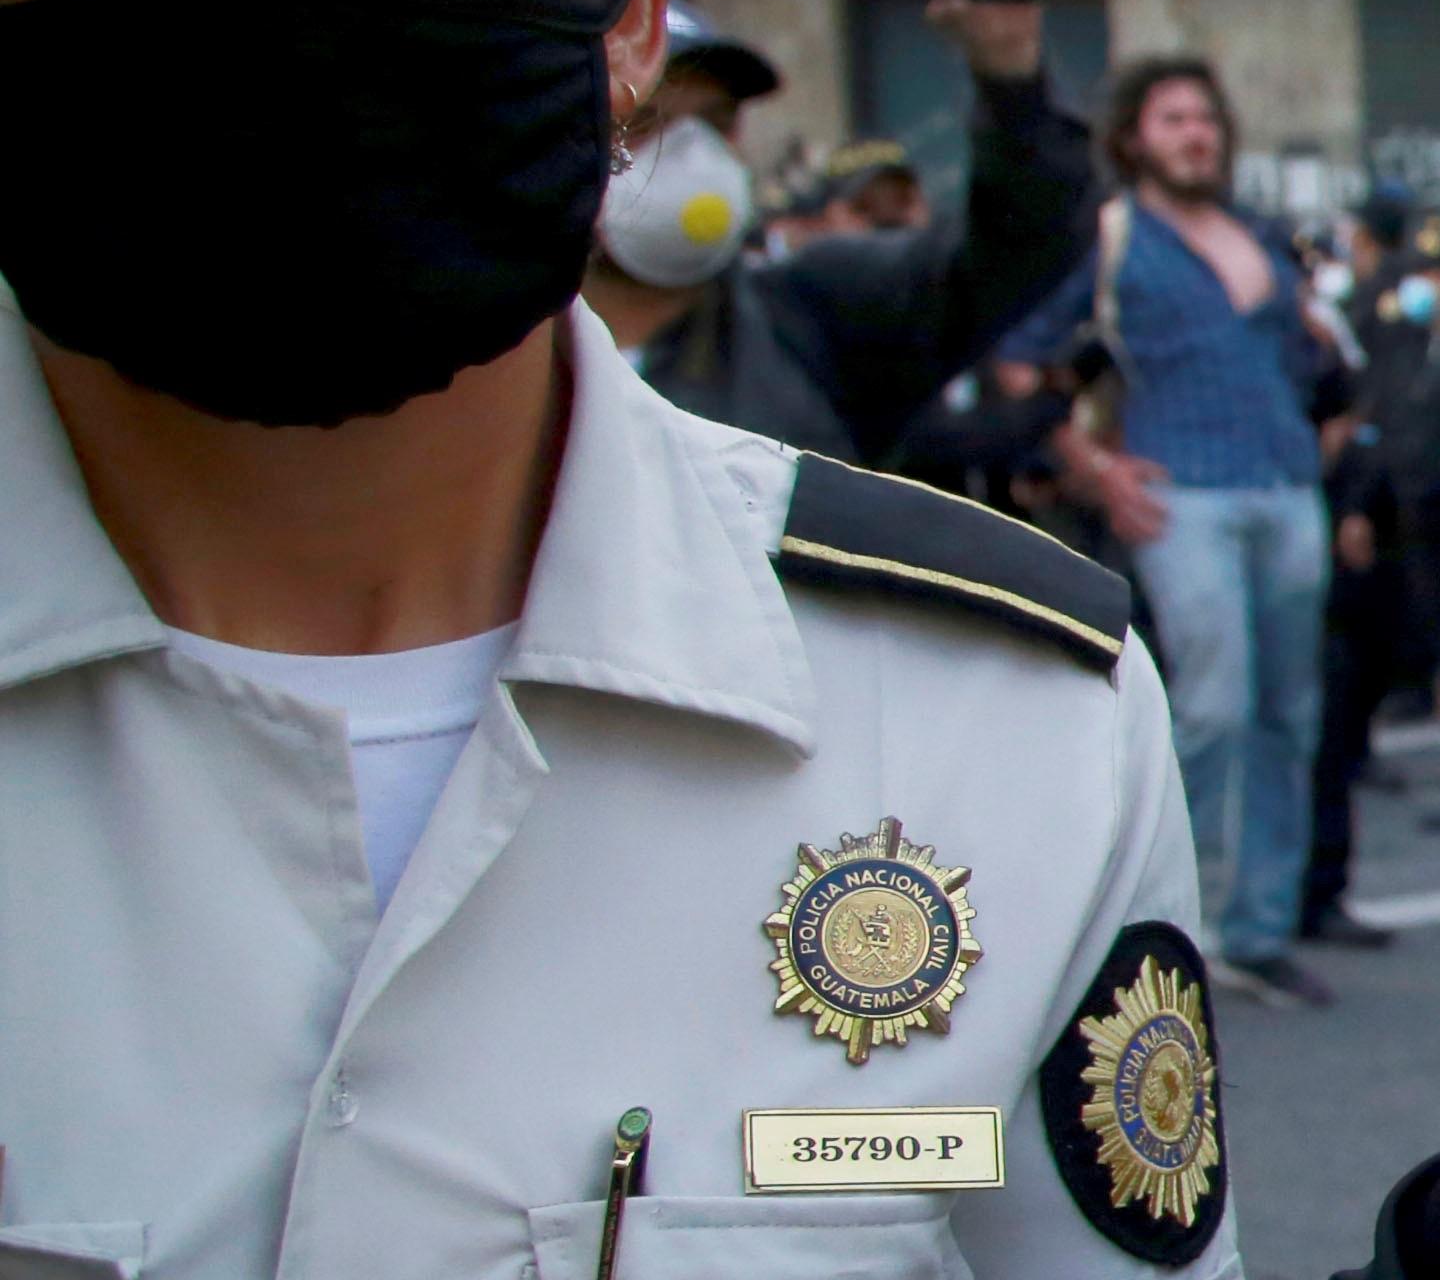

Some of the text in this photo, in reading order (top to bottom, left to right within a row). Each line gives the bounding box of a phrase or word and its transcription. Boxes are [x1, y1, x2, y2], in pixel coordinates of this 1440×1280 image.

[799, 869, 950, 970] POLICIA NACIONAL CIVIL
[811, 964, 930, 1009] GUATEMALA
[1119, 1048, 1147, 1123] POLICIA
[792, 1134, 964, 1162] 35790-P
